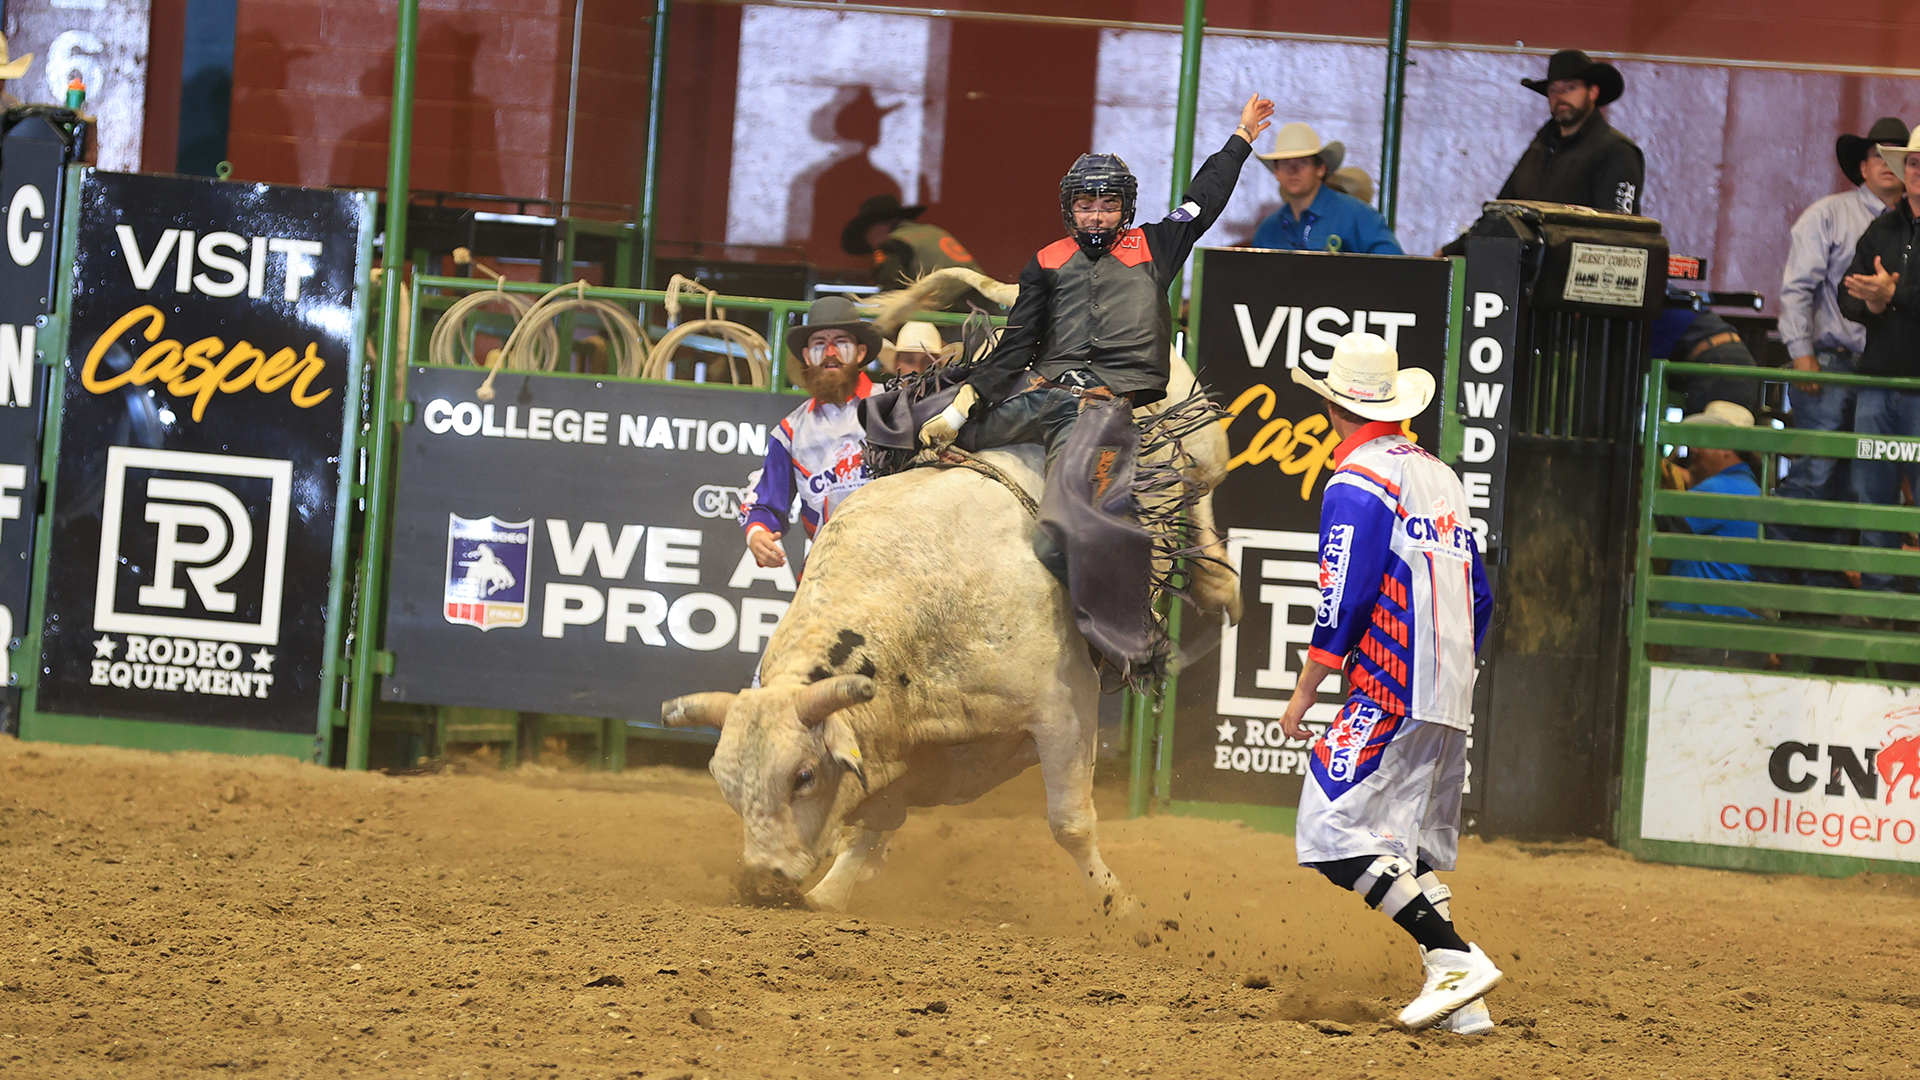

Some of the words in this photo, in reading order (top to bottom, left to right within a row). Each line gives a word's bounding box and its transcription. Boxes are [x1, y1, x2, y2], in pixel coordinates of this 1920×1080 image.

[46, 30, 103, 104] 6
[116, 225, 322, 301] VISIT
[1608, 254, 1642, 269] COWBOYS
[82, 305, 332, 422] Casper
[424, 398, 608, 444] COLLEGE
[618, 414, 769, 457] NATION
[1874, 440, 1920, 462] POW
[546, 518, 702, 585] WE
[90, 659, 274, 699] EQUIPMENT
[125, 635, 243, 670] RODEO
[1720, 799, 1916, 848] collegero
